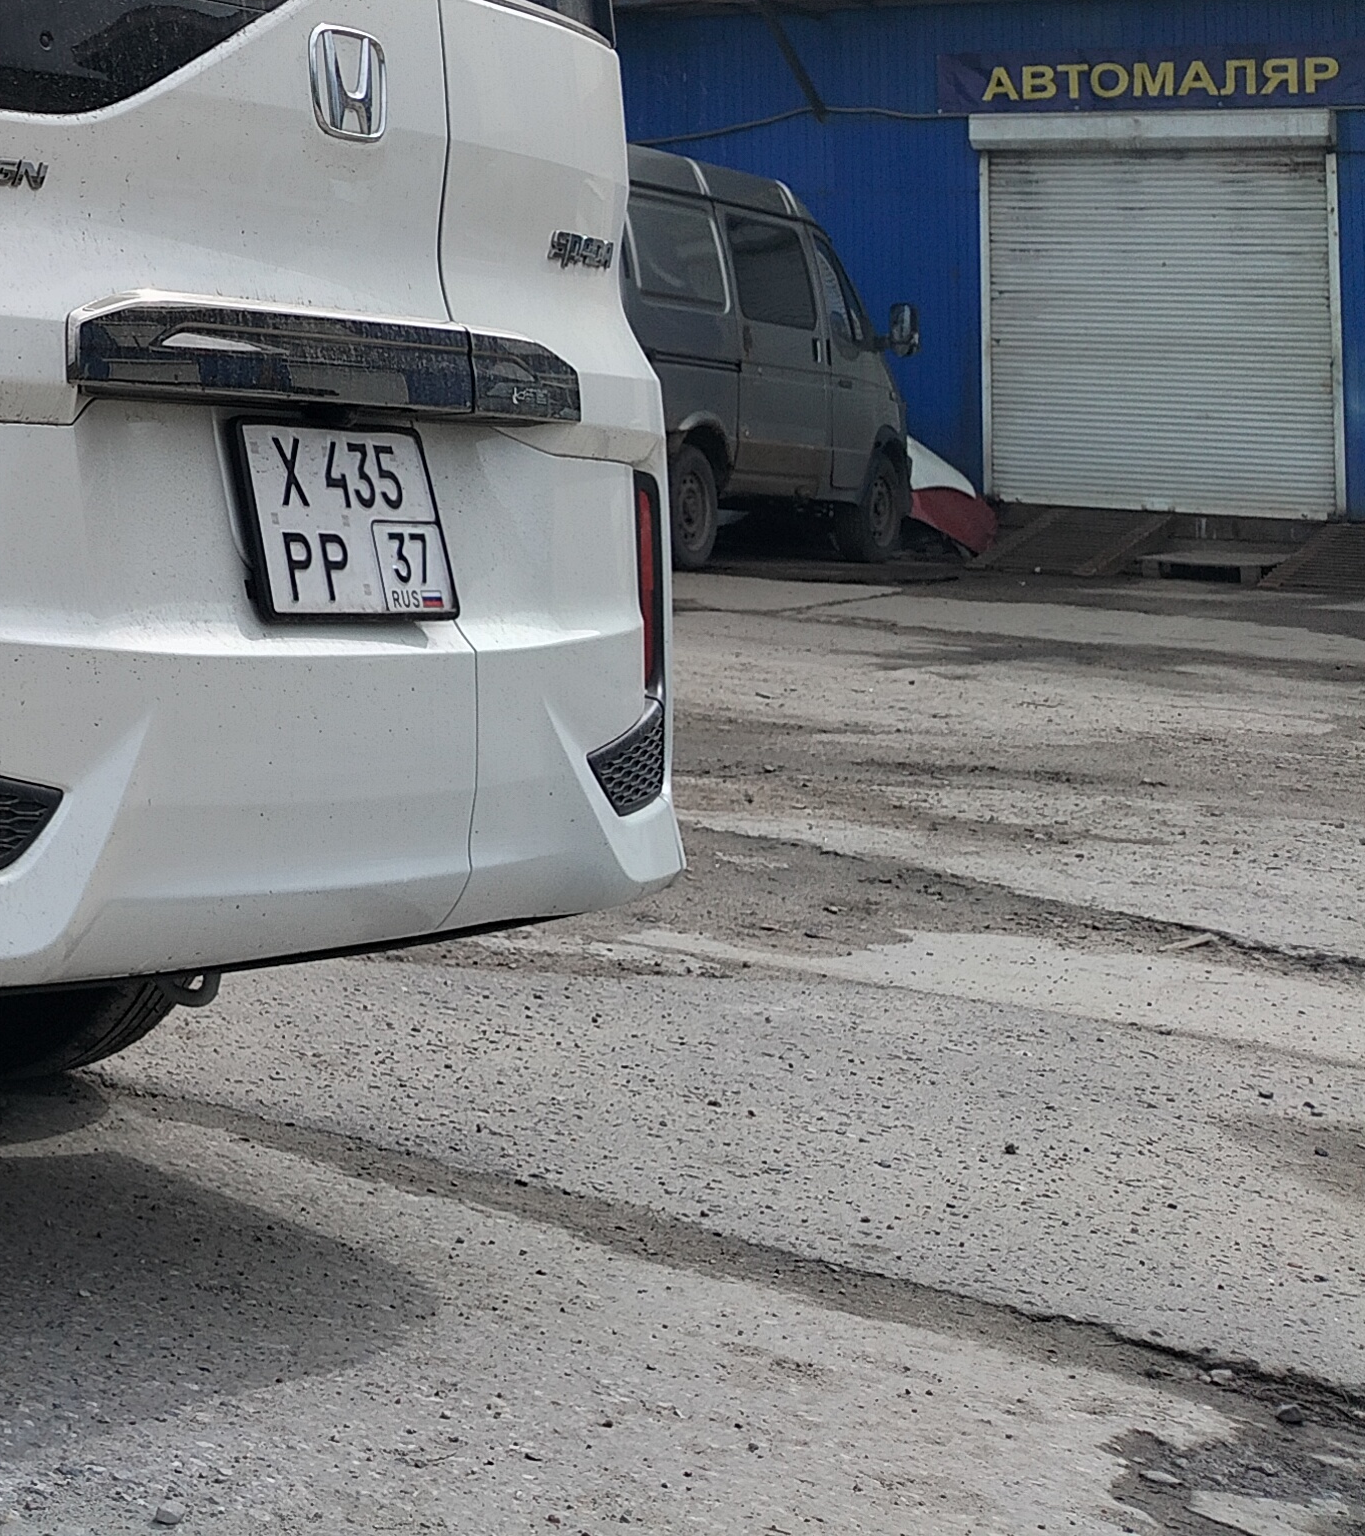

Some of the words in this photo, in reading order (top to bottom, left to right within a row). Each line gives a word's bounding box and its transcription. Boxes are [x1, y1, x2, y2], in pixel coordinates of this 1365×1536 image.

[981, 56, 1339, 102] АВТОМАЛЯР
[325, 441, 403, 510] 435
[387, 532, 428, 585] 37
[391, 590, 420, 608] RUS
